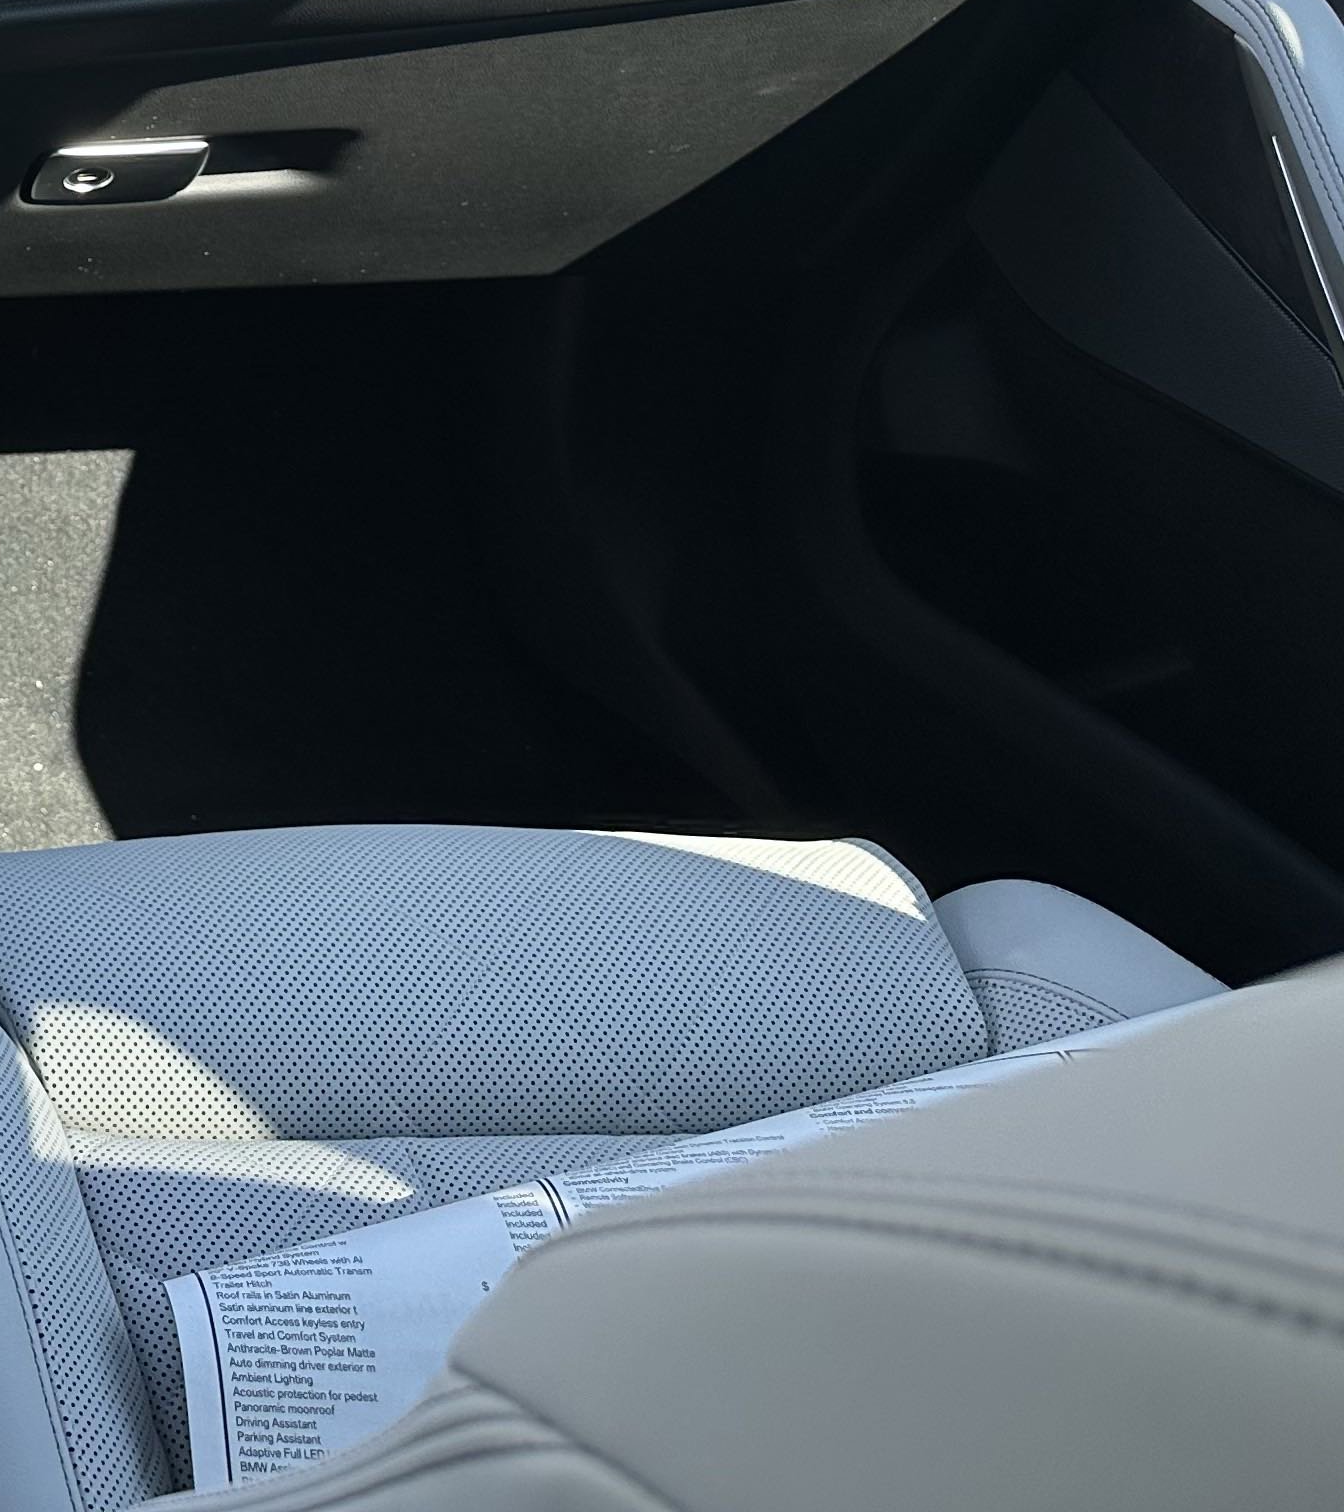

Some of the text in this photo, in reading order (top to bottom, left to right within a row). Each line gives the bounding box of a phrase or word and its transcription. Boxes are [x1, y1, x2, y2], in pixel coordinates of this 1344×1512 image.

[563, 1175, 629, 1187] Connectivity
[501, 1209, 543, 1218] Included
[283, 1267, 333, 1276] Automatic
[246, 1280, 273, 1288] Hitch
[216, 1291, 240, 1300] Roof
[274, 1291, 301, 1300] Satin
[302, 1291, 351, 1301] Aluminum
[246, 1303, 294, 1313] aluminum
[315, 1305, 351, 1315] exterior
[222, 1315, 365, 1331] Comfort Access keyless entry
[225, 1329, 356, 1344] Travel and Comfort System
[227, 1343, 312, 1356] Anthracite-Brown
[314, 1345, 345, 1358] Poplar
[229, 1357, 253, 1367] Auto
[254, 1358, 297, 1371] dimming
[298, 1360, 326, 1371] driver
[327, 1361, 364, 1372] exterior
[231, 1372, 314, 1386] Ambient Lighting
[233, 1386, 379, 1403] Acoustic protection for pedest
[234, 1401, 335, 1415] Panoramic moonroof
[235, 1415, 317, 1430] Driving Assistant
[237, 1431, 321, 1445] Parking Assistant
[238, 1446, 282, 1460] Adaptive
[284, 1447, 302, 1459] Full
[240, 1461, 267, 1473] BMW
